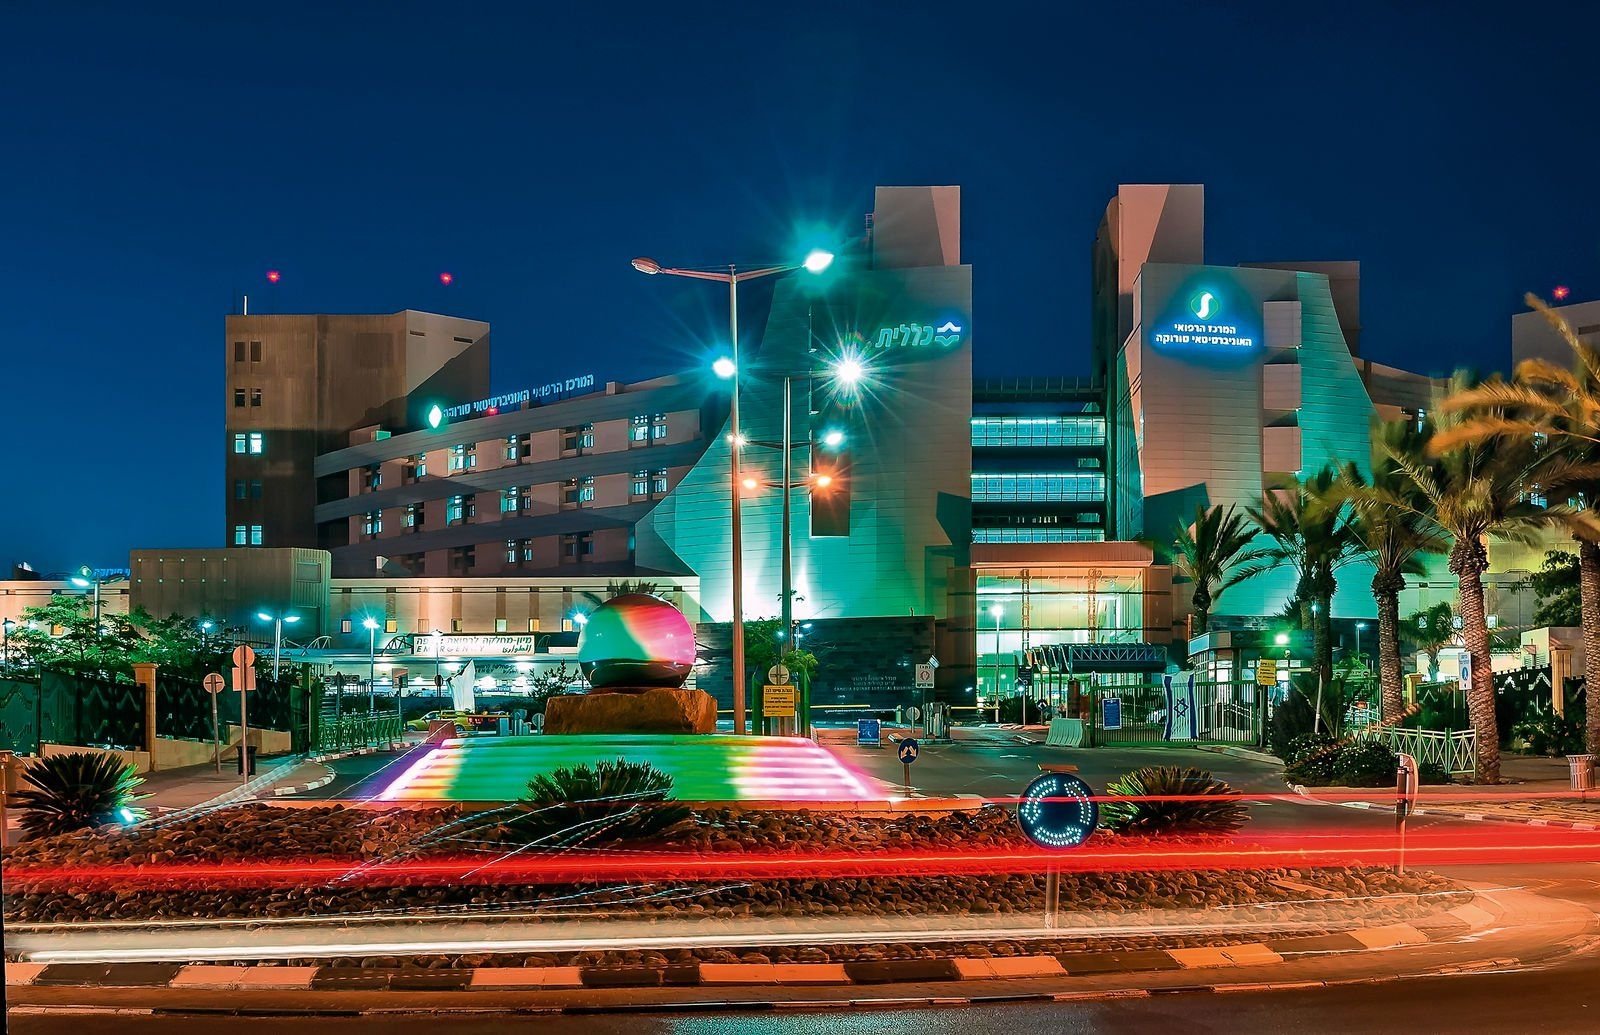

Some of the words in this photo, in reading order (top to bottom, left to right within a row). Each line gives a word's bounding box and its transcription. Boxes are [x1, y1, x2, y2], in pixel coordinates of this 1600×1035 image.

[1174, 323, 1206, 333] הרפואי
[1207, 324, 1236, 335] המרכז
[875, 323, 934, 348] כללית
[1156, 334, 1190, 344] סורוקה
[565, 374, 594, 391] המרכז
